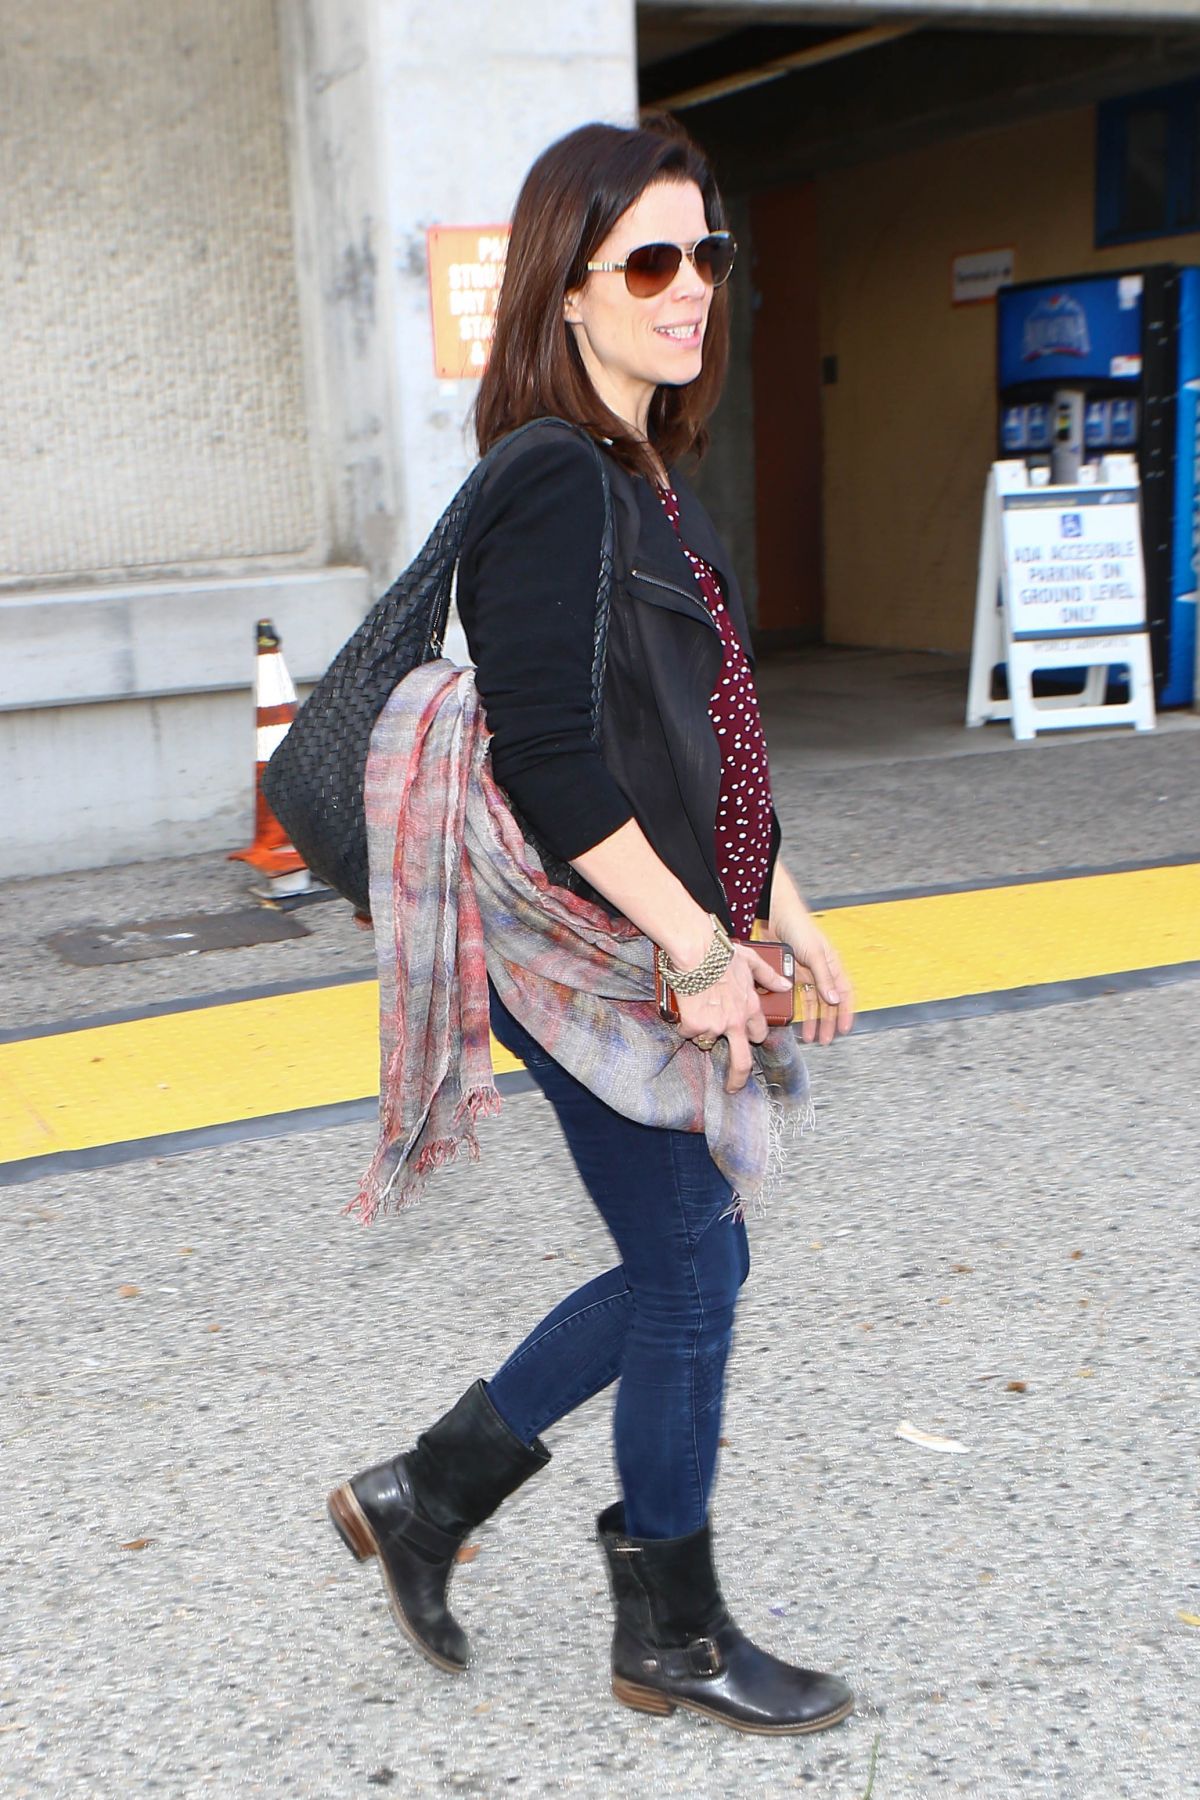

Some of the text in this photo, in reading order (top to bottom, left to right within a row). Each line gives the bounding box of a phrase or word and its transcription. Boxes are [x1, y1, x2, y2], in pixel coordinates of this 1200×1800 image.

[1015, 541, 1135, 562] ADA ACCESSIBLE
[1029, 562, 1121, 581] PARKING ON
[1020, 582, 1134, 605] GROUND LEVEL
[1061, 606, 1098, 623] ONLY
